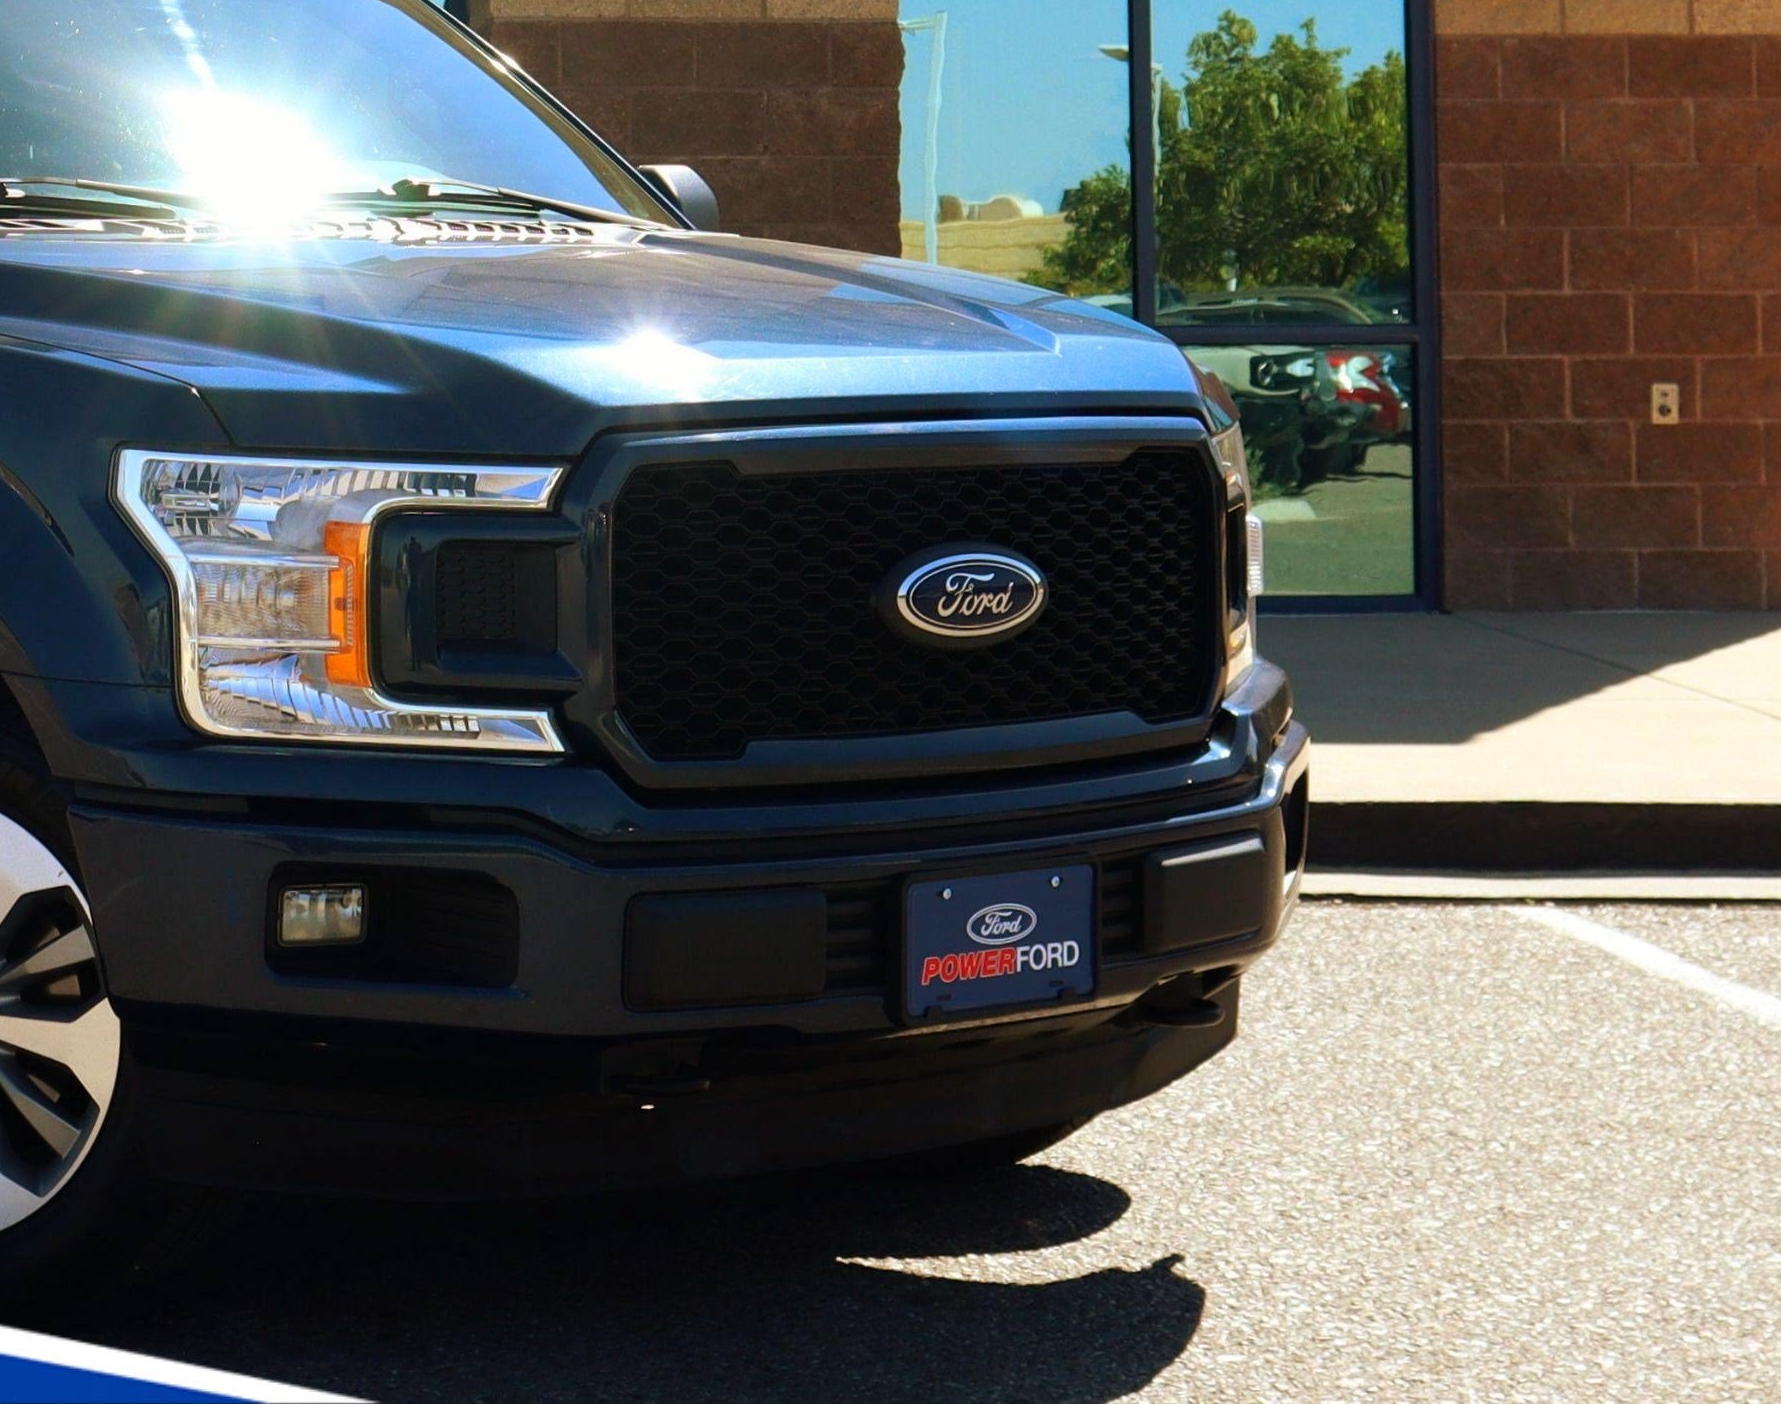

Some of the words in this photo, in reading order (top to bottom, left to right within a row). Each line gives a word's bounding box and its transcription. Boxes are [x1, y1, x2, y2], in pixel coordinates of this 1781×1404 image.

[937, 572, 1014, 618] Ford
[980, 911, 1022, 936] Ford
[920, 940, 1080, 986] POWERFORD
